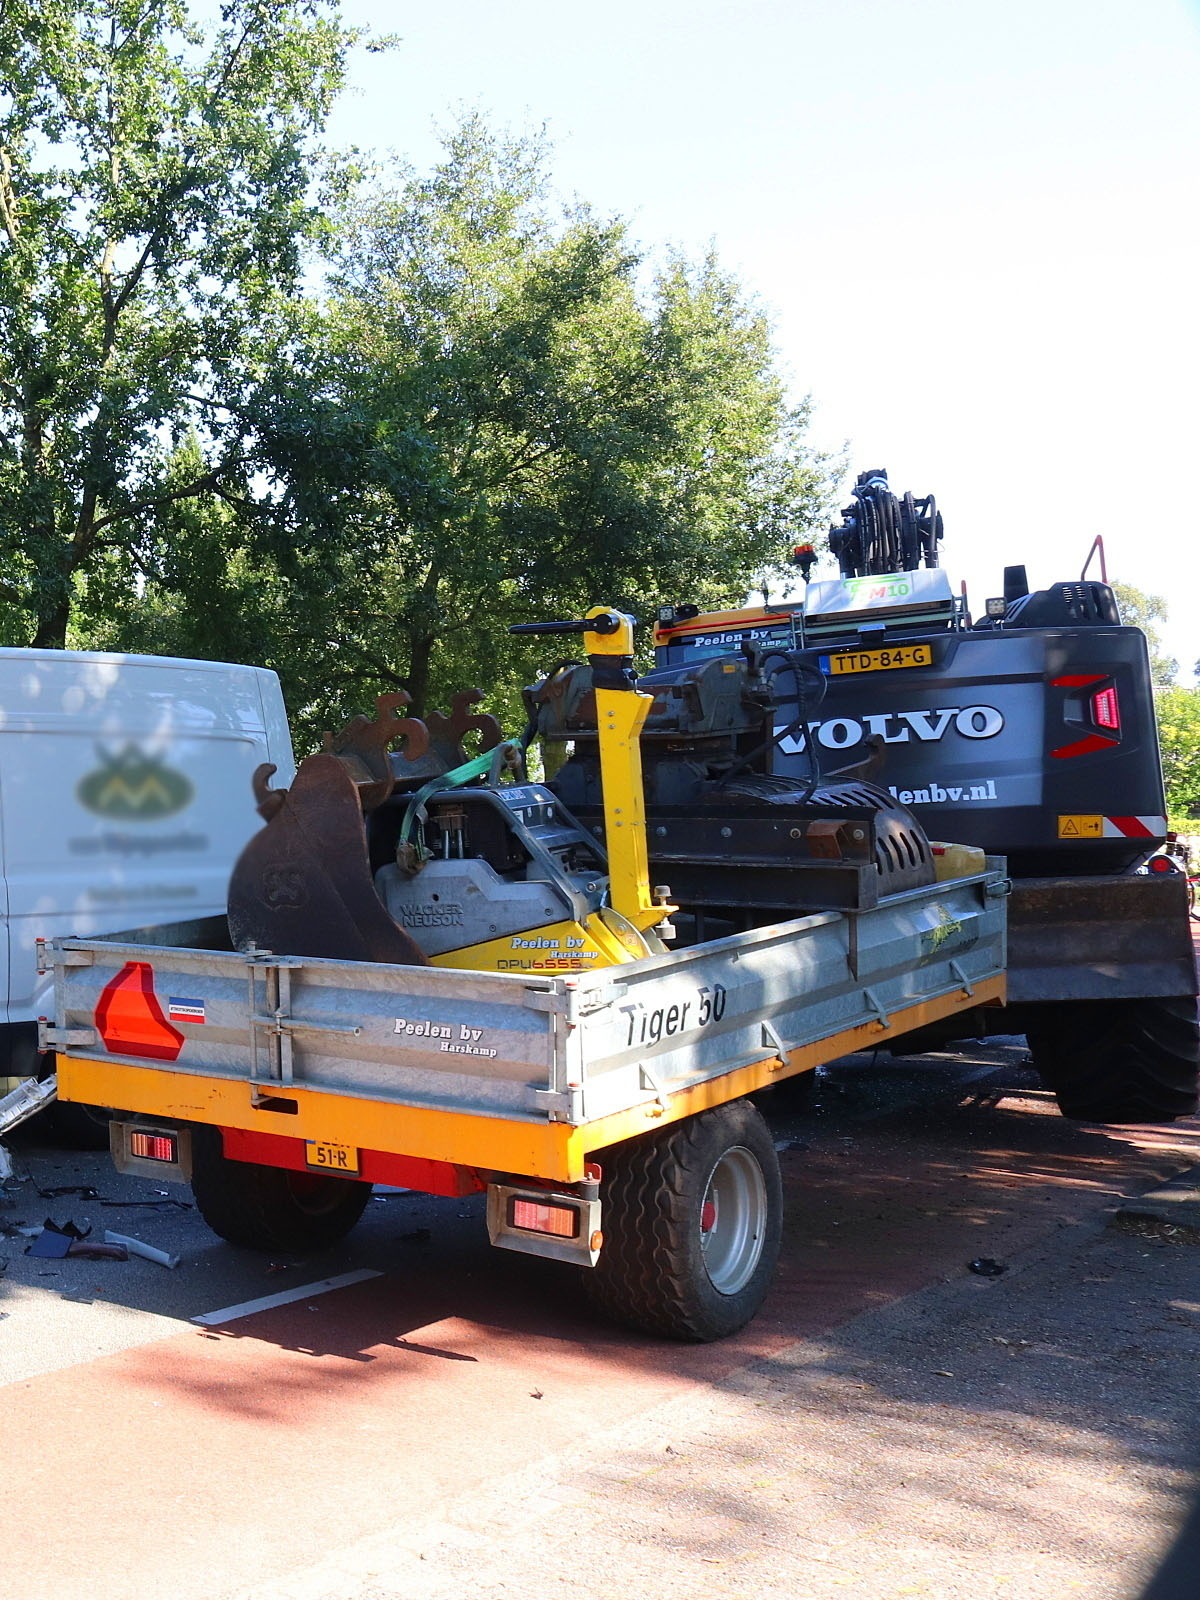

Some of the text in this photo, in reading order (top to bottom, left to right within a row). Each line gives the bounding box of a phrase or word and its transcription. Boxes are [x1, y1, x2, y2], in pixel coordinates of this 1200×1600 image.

[694, 630, 769, 648] Peelen bv
[835, 648, 925, 671] TTD-84-G
[772, 704, 1004, 755] VOLVO
[400, 904, 464, 916] WACKER
[402, 914, 464, 927] NEUSON
[511, 936, 585, 949] Peelen bv
[550, 951, 598, 959] Harskamp
[497, 959, 582, 969] DPU6555
[618, 983, 727, 1049] Tiger 50
[393, 1018, 482, 1041] Peelen bv
[440, 1041, 497, 1058] Harskamp
[317, 1147, 348, 1167] 51-R
